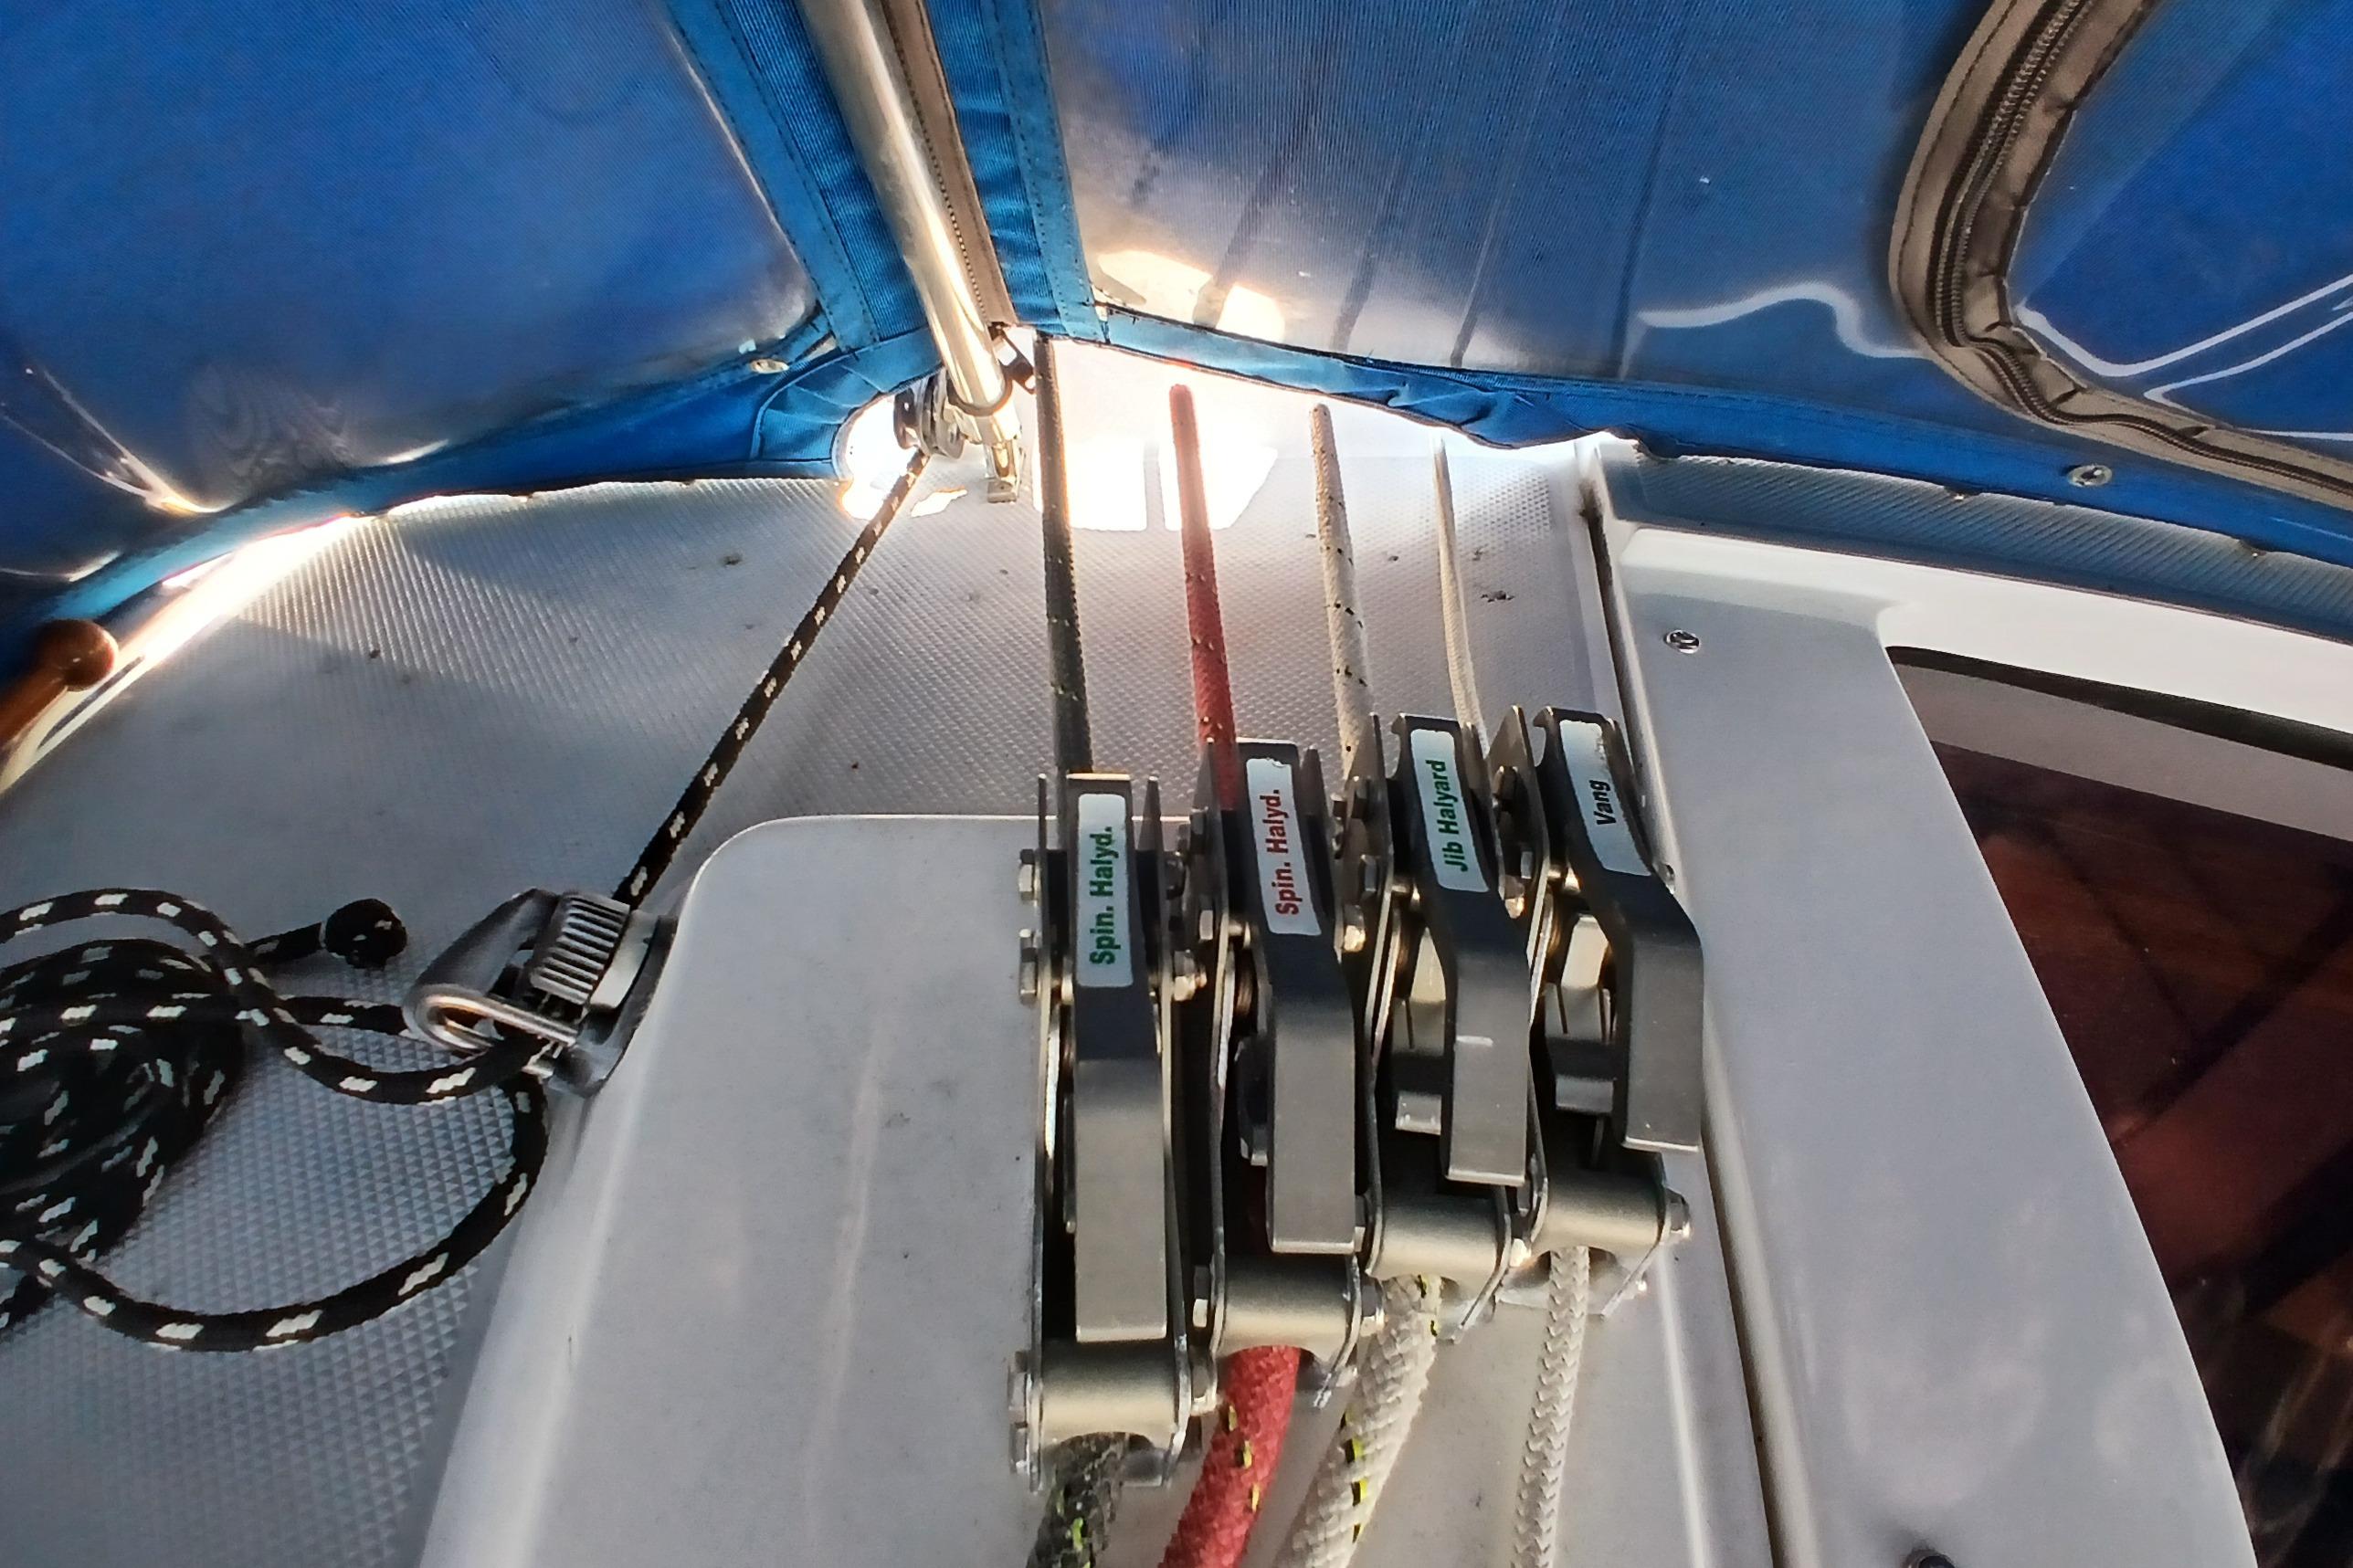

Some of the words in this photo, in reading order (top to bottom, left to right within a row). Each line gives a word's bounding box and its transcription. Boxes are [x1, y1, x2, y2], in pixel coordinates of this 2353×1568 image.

[1260, 789, 1289, 854] Halyd.
[1425, 759, 1459, 835] Halyard
[1589, 779, 1617, 826] Vang
[1090, 826, 1119, 897] Halyd.
[1441, 841, 1468, 872] Jib
[1271, 862, 1303, 915] Spin.
[1089, 906, 1121, 964] Spin.
